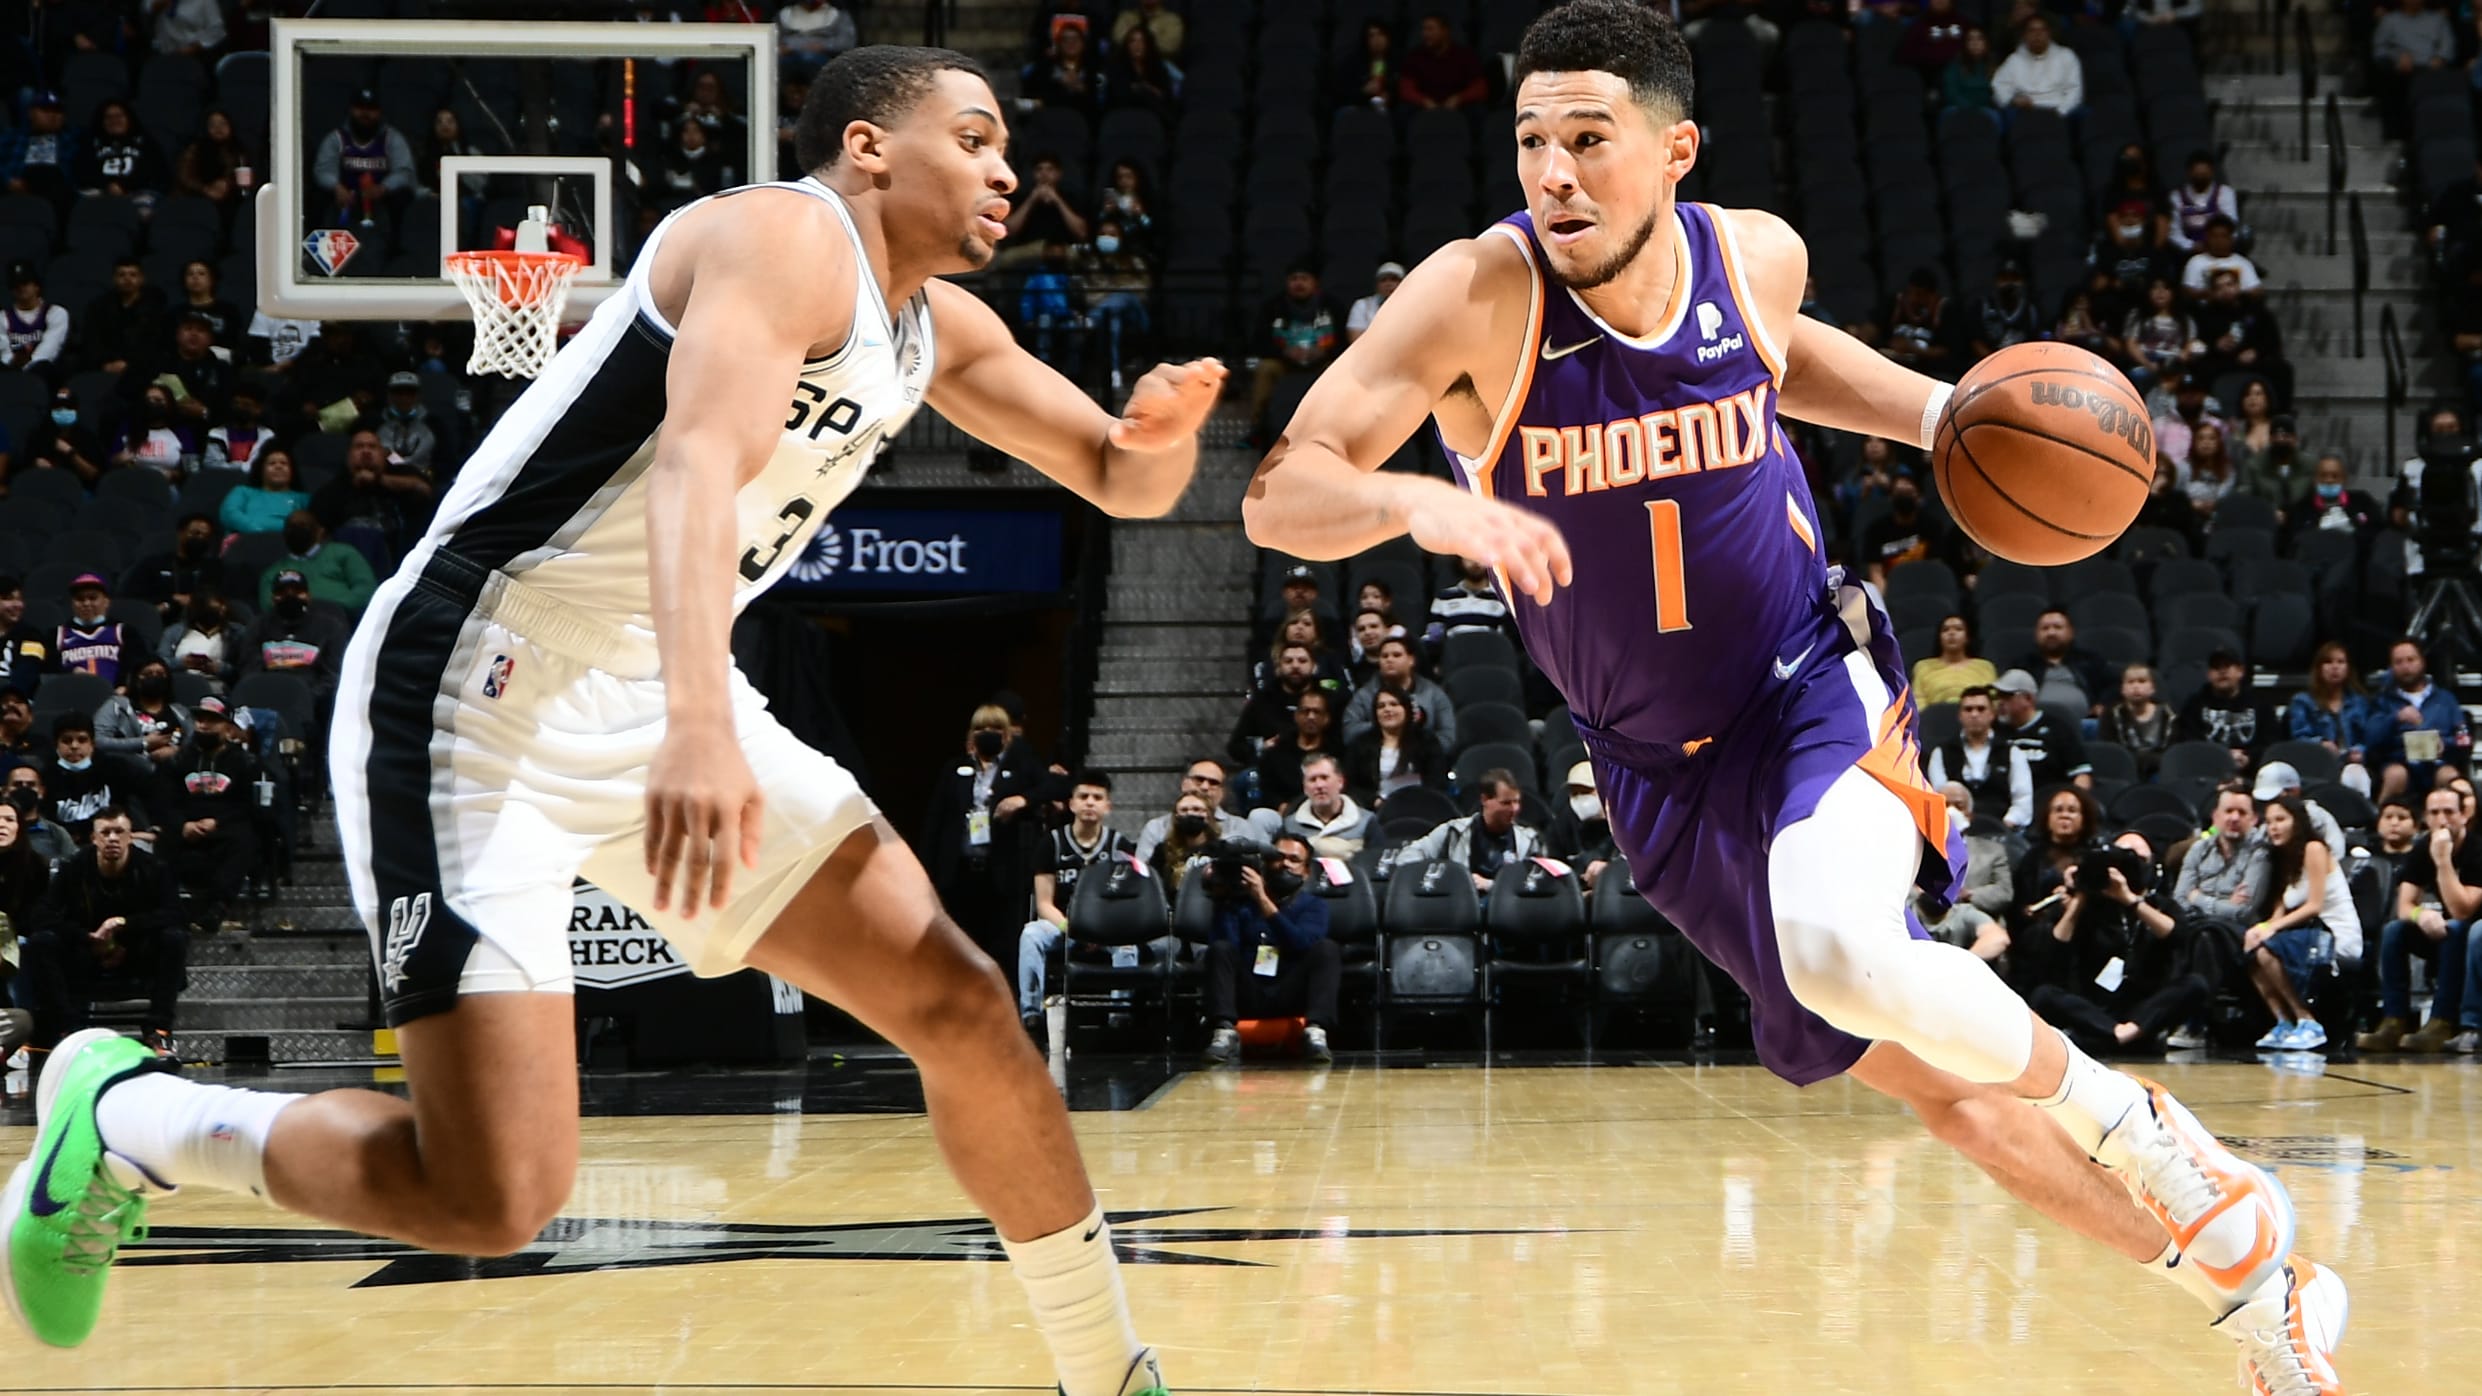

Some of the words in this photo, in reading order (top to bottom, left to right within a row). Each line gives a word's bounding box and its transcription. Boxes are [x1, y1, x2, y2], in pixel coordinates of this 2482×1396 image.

[1697, 333, 1743, 363] PayPal
[1519, 380, 1770, 497] PHOENIX
[2030, 381, 2150, 465] Wilson
[850, 528, 967, 574] Frost
[1644, 498, 1693, 634] 1
[61, 645, 120, 665] PHOENIX
[567, 905, 655, 932] RAK
[568, 938, 674, 965] HECK
